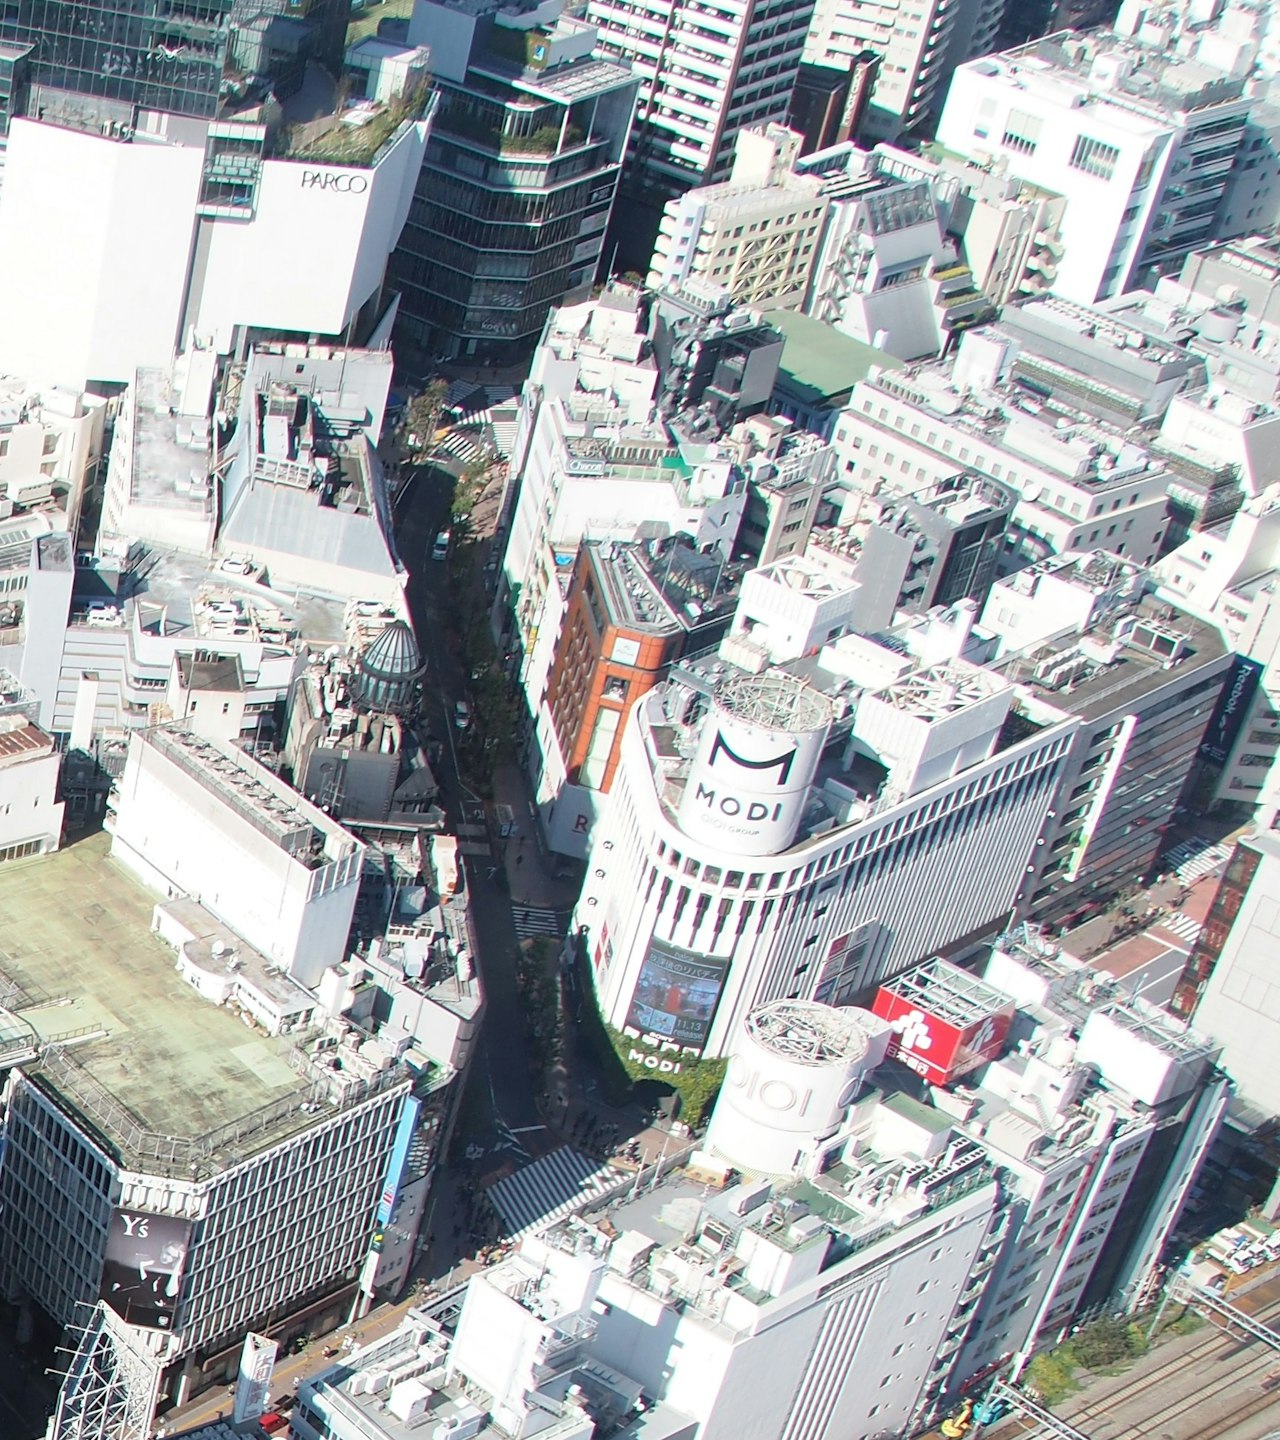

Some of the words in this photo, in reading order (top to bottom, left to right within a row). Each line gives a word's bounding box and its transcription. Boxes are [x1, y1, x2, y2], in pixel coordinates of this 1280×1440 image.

[301, 170, 367, 194] PARCO
[1224, 663, 1252, 715] Reebok
[695, 780, 782, 822] MODI
[673, 1028, 703, 1040] release
[676, 1019, 701, 1032] 11.13
[628, 1048, 682, 1074] MODI
[120, 1213, 149, 1239] Y's
